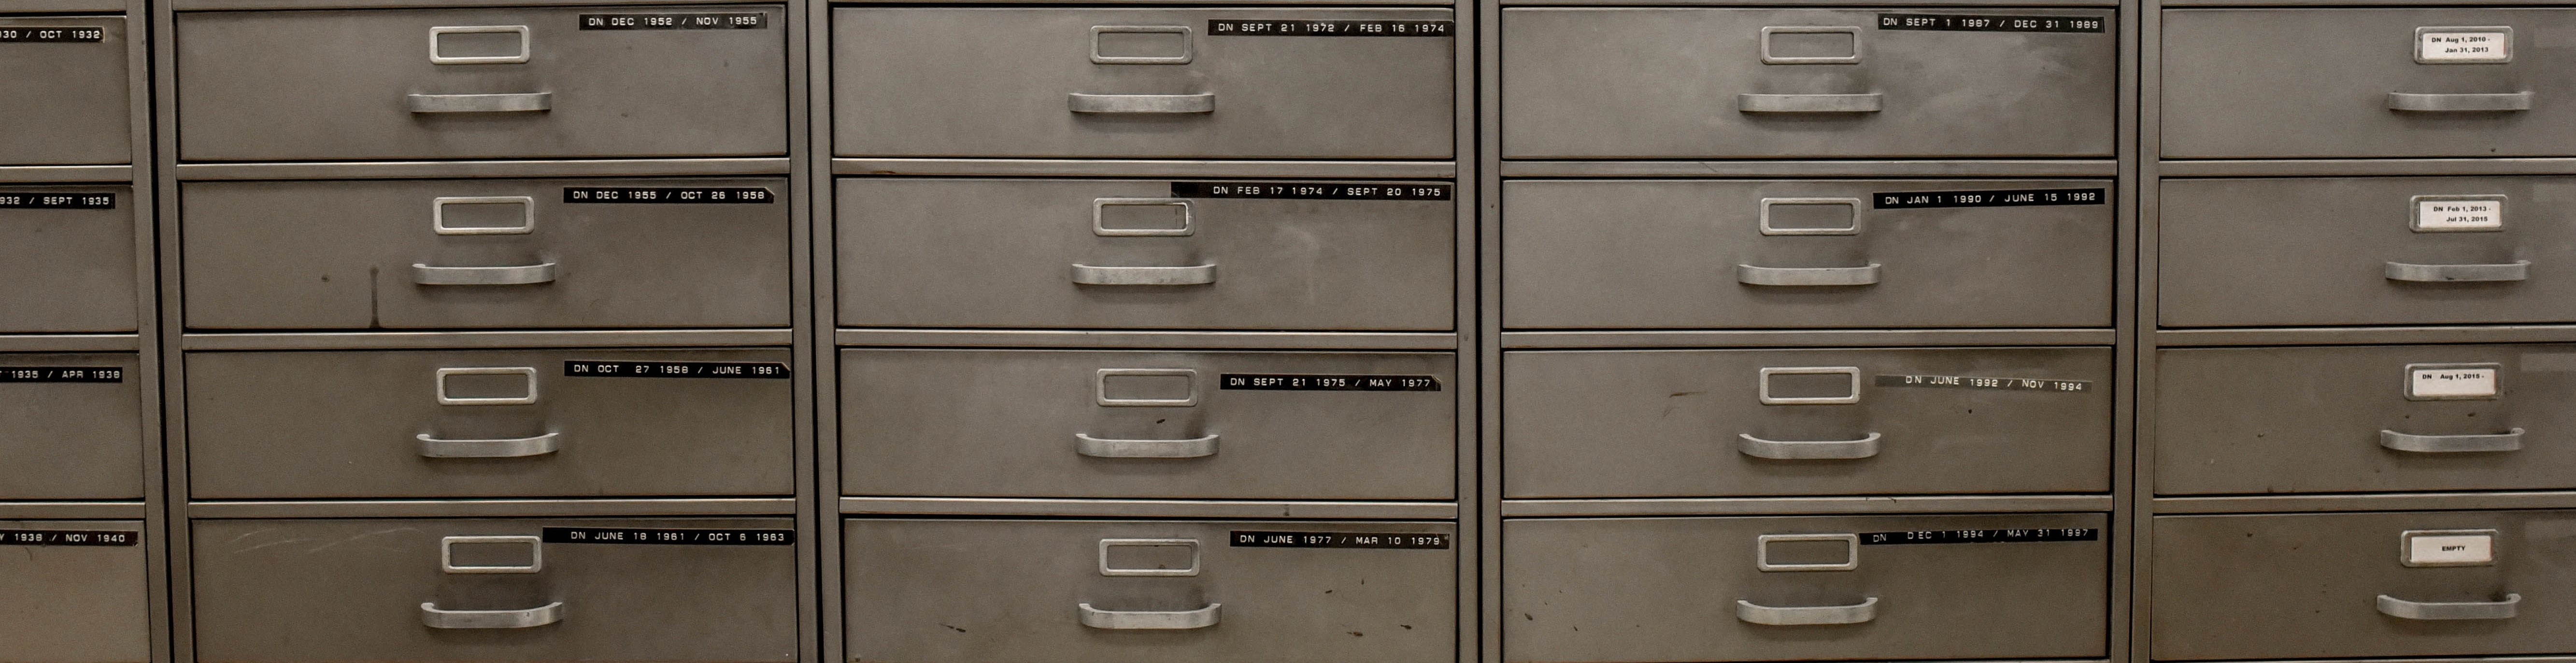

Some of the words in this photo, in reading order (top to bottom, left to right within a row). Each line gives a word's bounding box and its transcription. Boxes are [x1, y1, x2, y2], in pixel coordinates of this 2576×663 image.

[1907, 18, 1936, 27] SEPT
[1886, 197, 1899, 205] DN
[1954, 195, 1981, 203] 1990
[2005, 194, 2034, 202] JUNE
[2045, 193, 2057, 202] 15
[2067, 193, 2095, 201] 1992
[1931, 376, 1959, 385] JUNE
[1971, 379, 1998, 387] 1992
[2022, 380, 2044, 388] NOV
[2055, 382, 2082, 390] 1994
[1907, 531, 1932, 539] DEC
